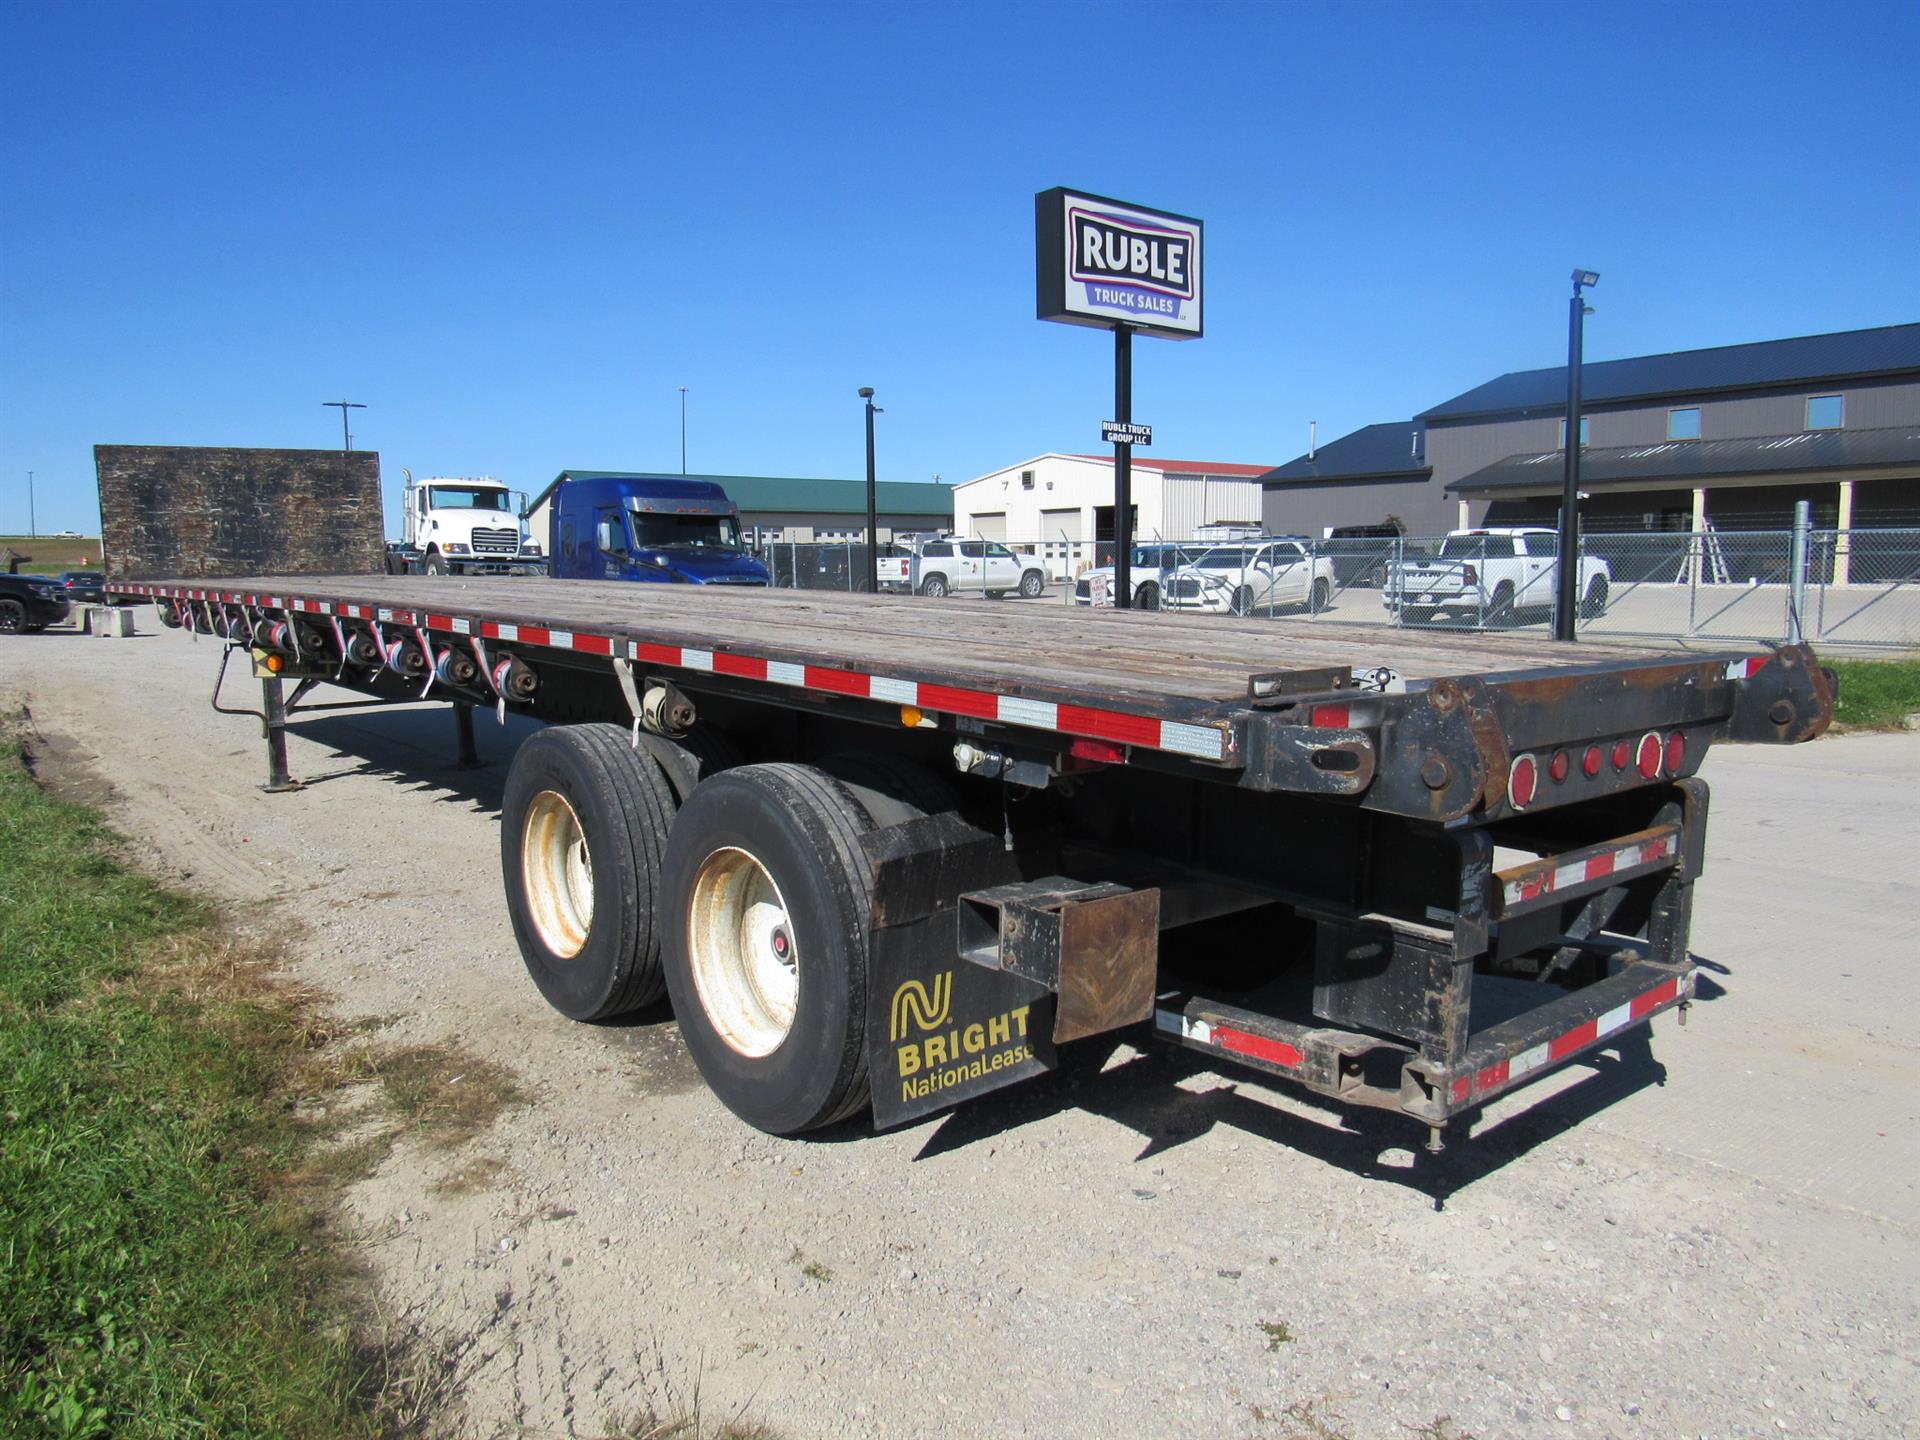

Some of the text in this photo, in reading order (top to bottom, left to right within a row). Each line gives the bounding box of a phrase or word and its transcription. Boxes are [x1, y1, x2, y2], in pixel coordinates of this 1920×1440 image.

[1083, 225, 1184, 284] RUBLE
[1094, 287, 1173, 313] TRUCK SALES
[1103, 422, 1151, 435] RUBLE TRUCK
[1107, 432, 1147, 444] GROUP LLC
[898, 1005, 1030, 1077] BRIGHT
